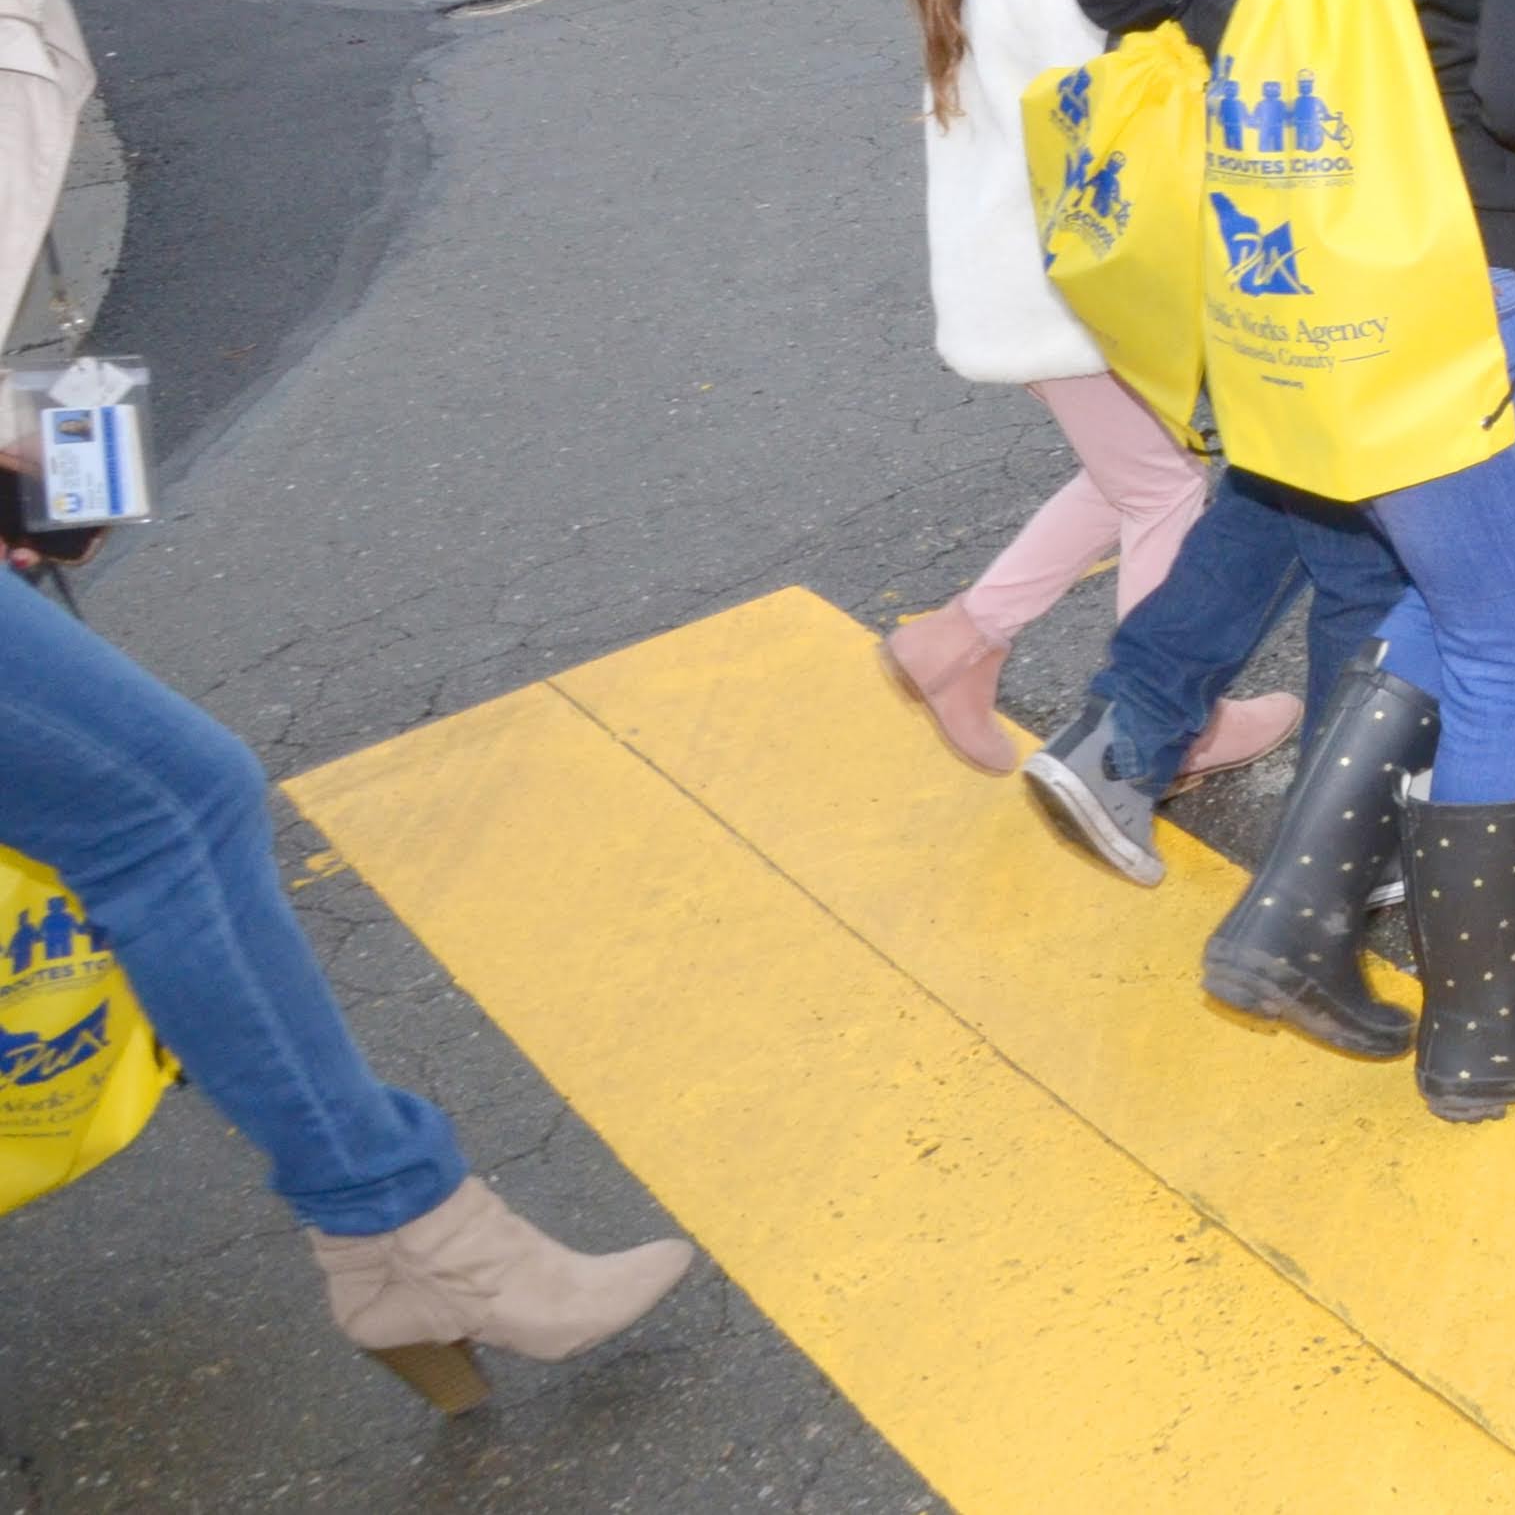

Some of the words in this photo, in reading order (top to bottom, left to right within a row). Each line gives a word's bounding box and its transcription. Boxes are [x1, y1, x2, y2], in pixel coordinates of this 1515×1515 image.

[1217, 156, 1285, 175] ROUTES
[1290, 157, 1354, 173] CHOO
[1295, 316, 1390, 352] Agency
[1278, 348, 1336, 374] County
